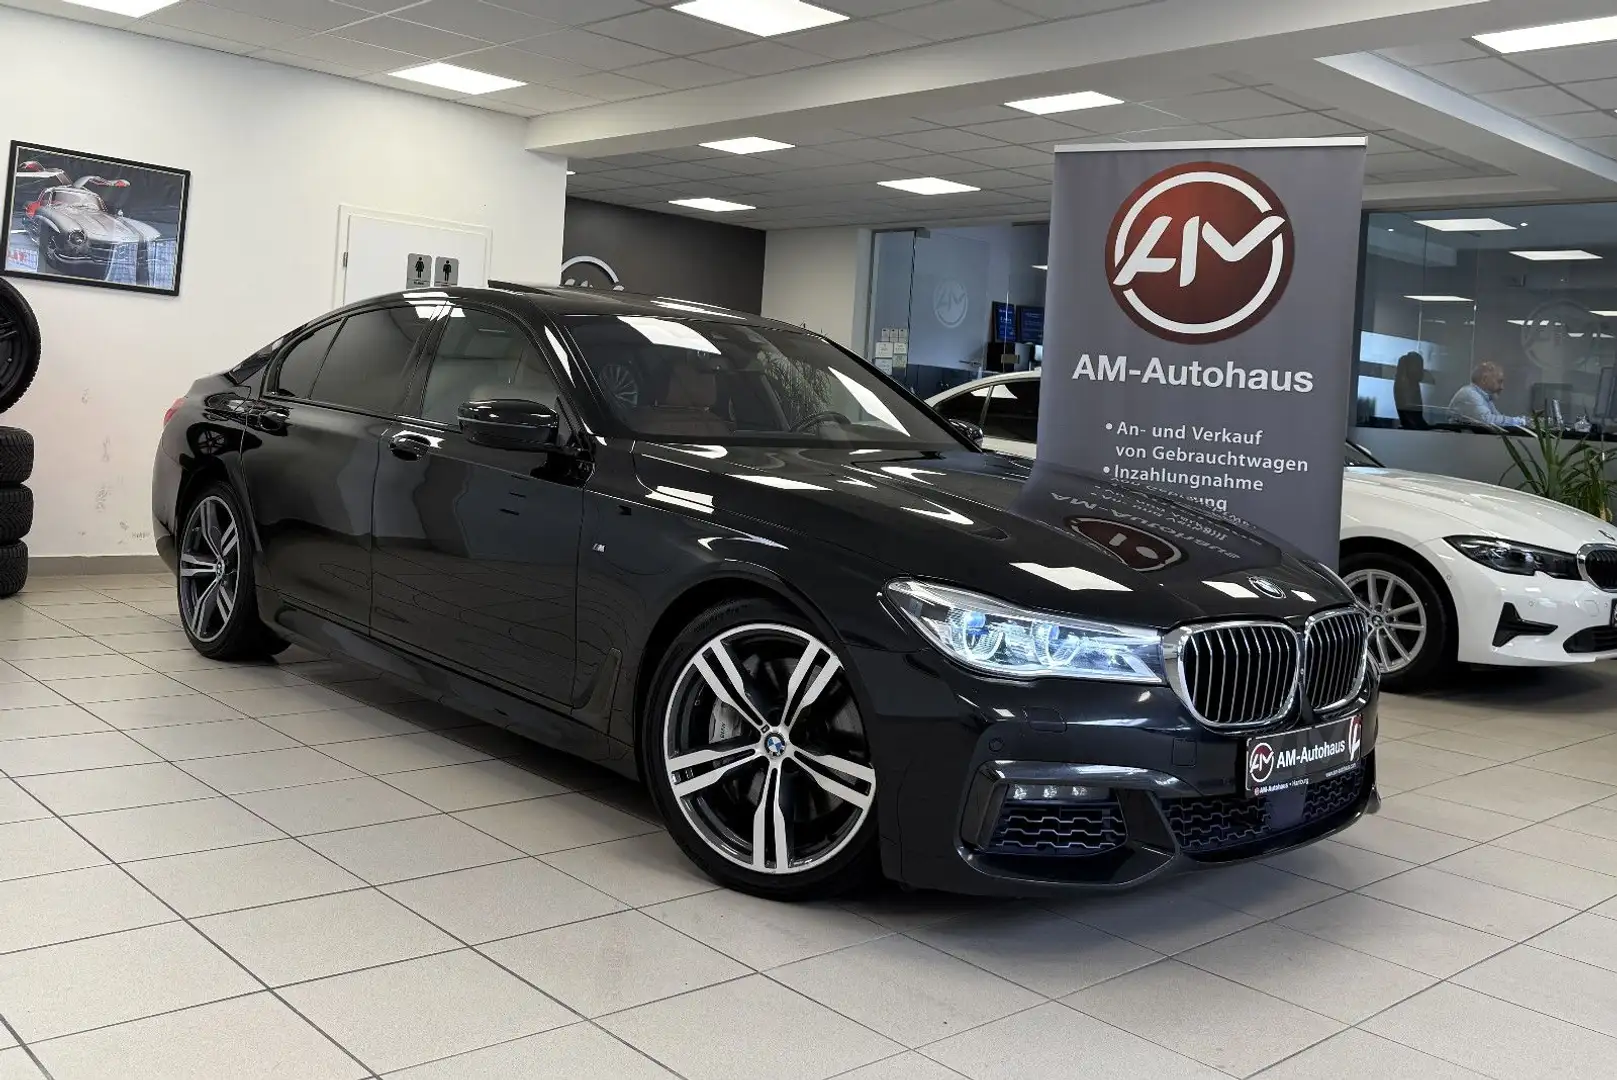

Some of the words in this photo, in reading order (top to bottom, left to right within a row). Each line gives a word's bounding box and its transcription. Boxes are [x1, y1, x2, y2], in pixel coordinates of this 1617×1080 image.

[1072, 353, 1314, 393] AM-Autohaus
[1116, 421, 1146, 436] An-
[1152, 425, 1186, 440] und
[1192, 426, 1263, 445] Verkauf
[1115, 445, 1146, 459] von
[1152, 446, 1308, 473] Gebrauchtwagen
[1114, 464, 1264, 491] Inzahlungnahme
[1276, 740, 1345, 769] AM-Autohaus
